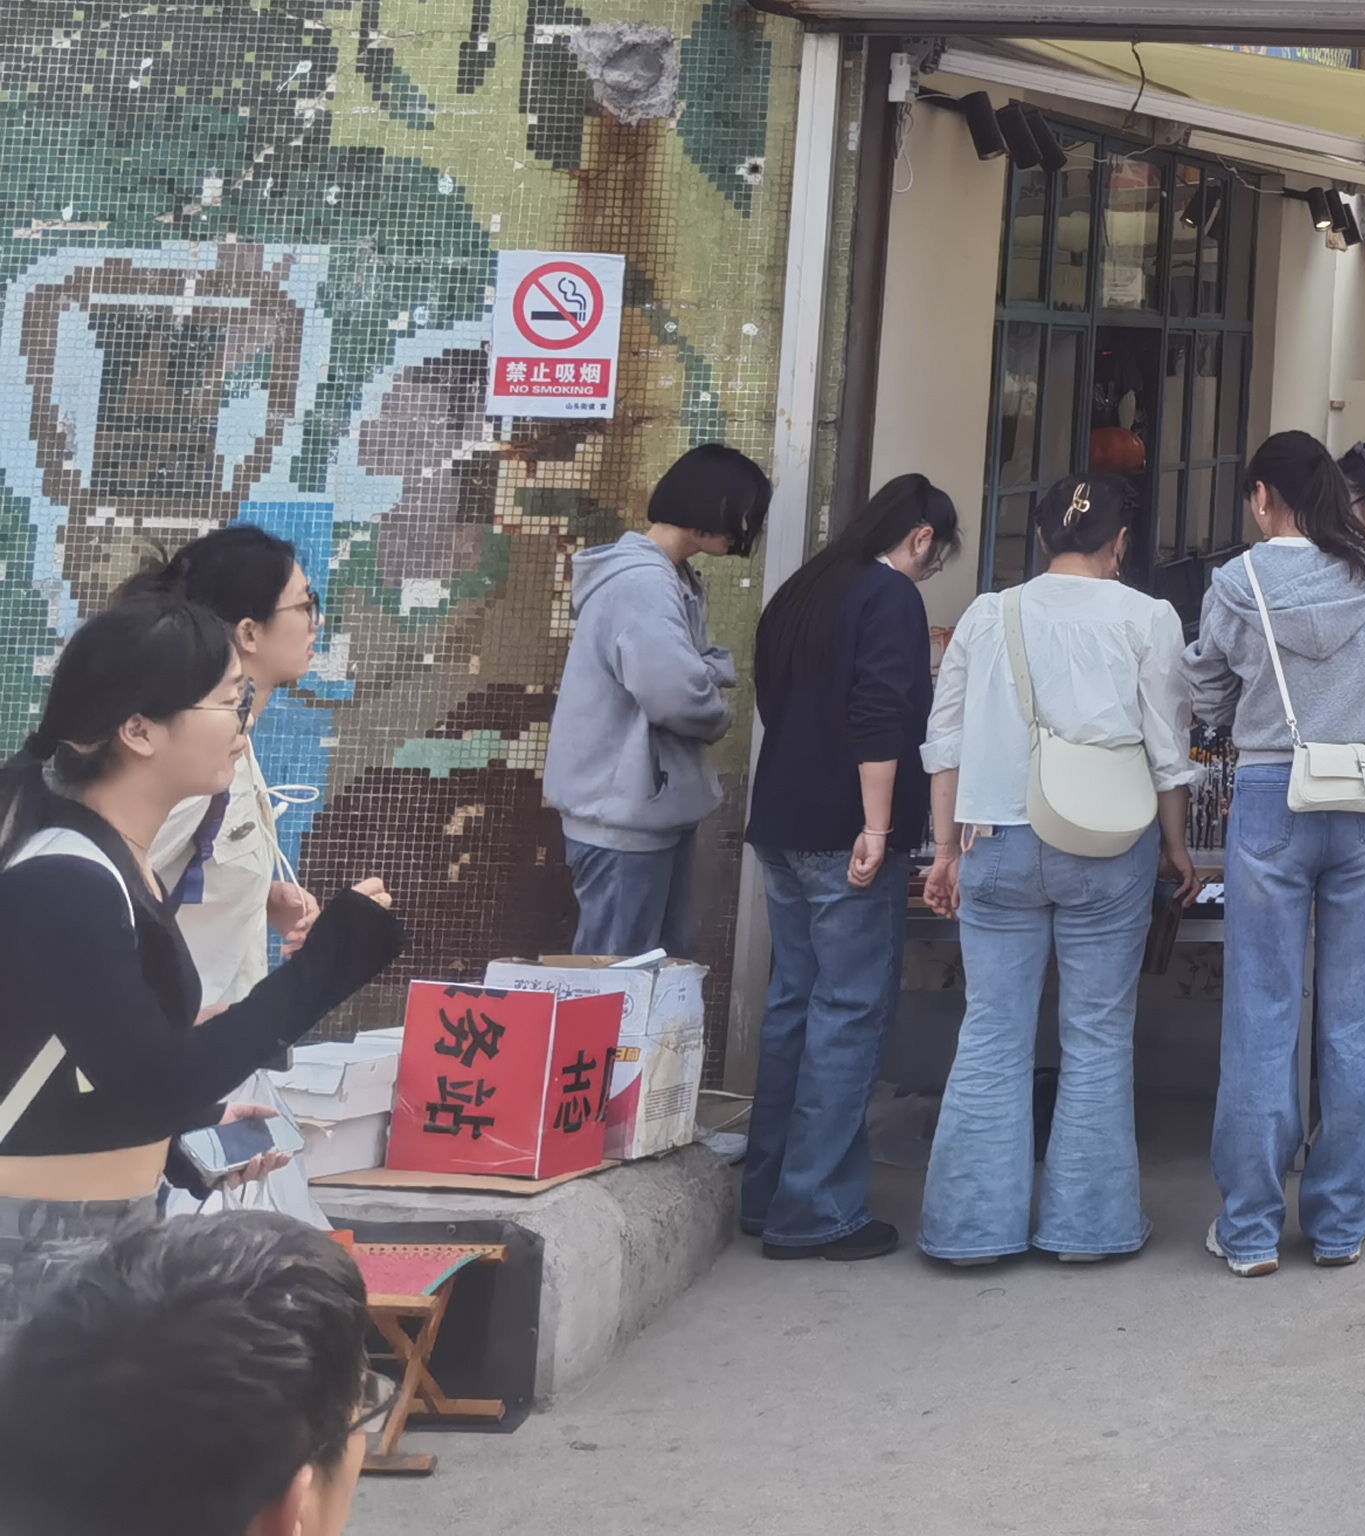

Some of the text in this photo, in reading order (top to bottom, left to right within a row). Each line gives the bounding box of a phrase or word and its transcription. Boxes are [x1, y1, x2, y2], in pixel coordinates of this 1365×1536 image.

[506, 361, 602, 384] 禁止吸烟
[509, 385, 594, 395] NO SMOKING
[565, 402, 596, 411] 山头街道
[423, 986, 509, 1140] 务站
